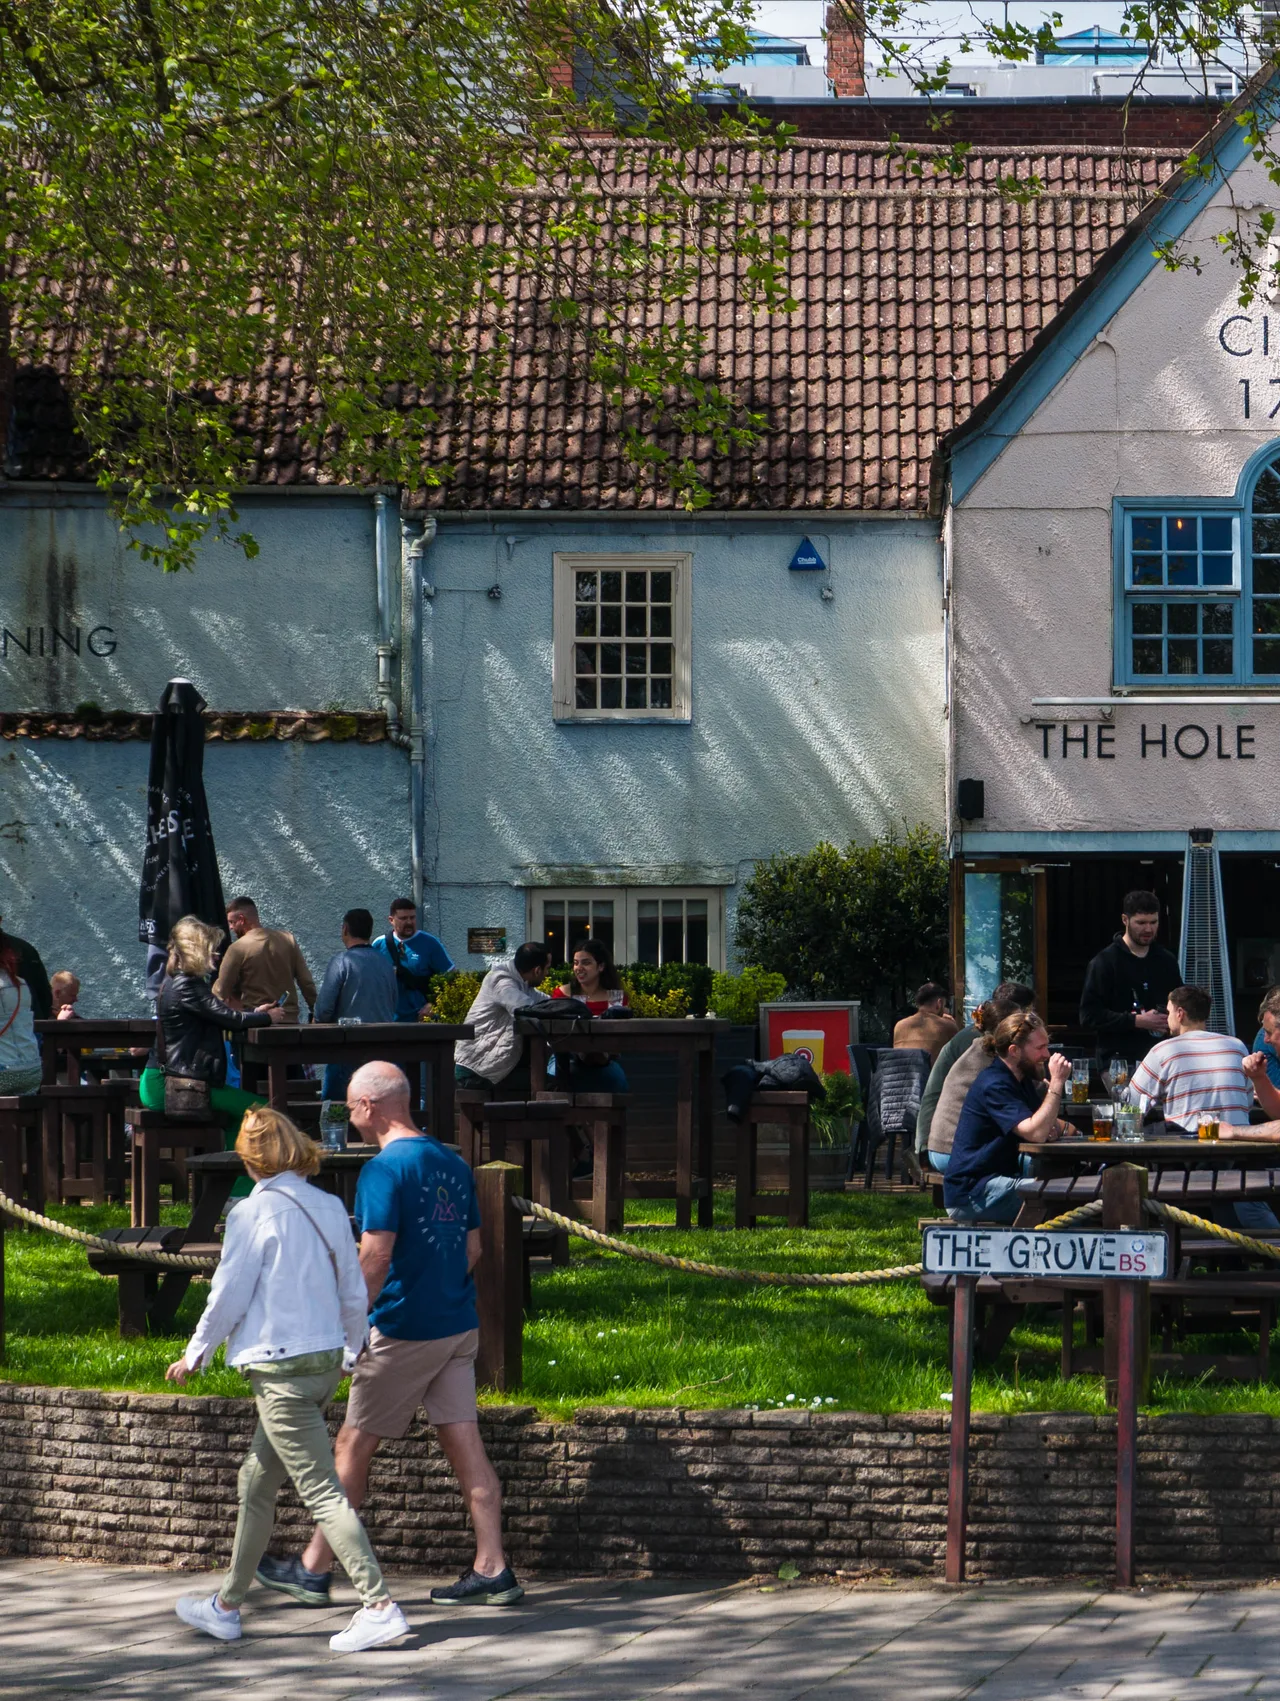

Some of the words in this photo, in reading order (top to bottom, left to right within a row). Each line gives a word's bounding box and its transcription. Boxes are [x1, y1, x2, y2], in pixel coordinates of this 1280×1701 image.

[3, 625, 117, 658] NING
[1034, 723, 1116, 760] THE
[1140, 723, 1256, 761] HOLE
[932, 1234, 992, 1268] THE
[1008, 1234, 1116, 1271] GROVE
